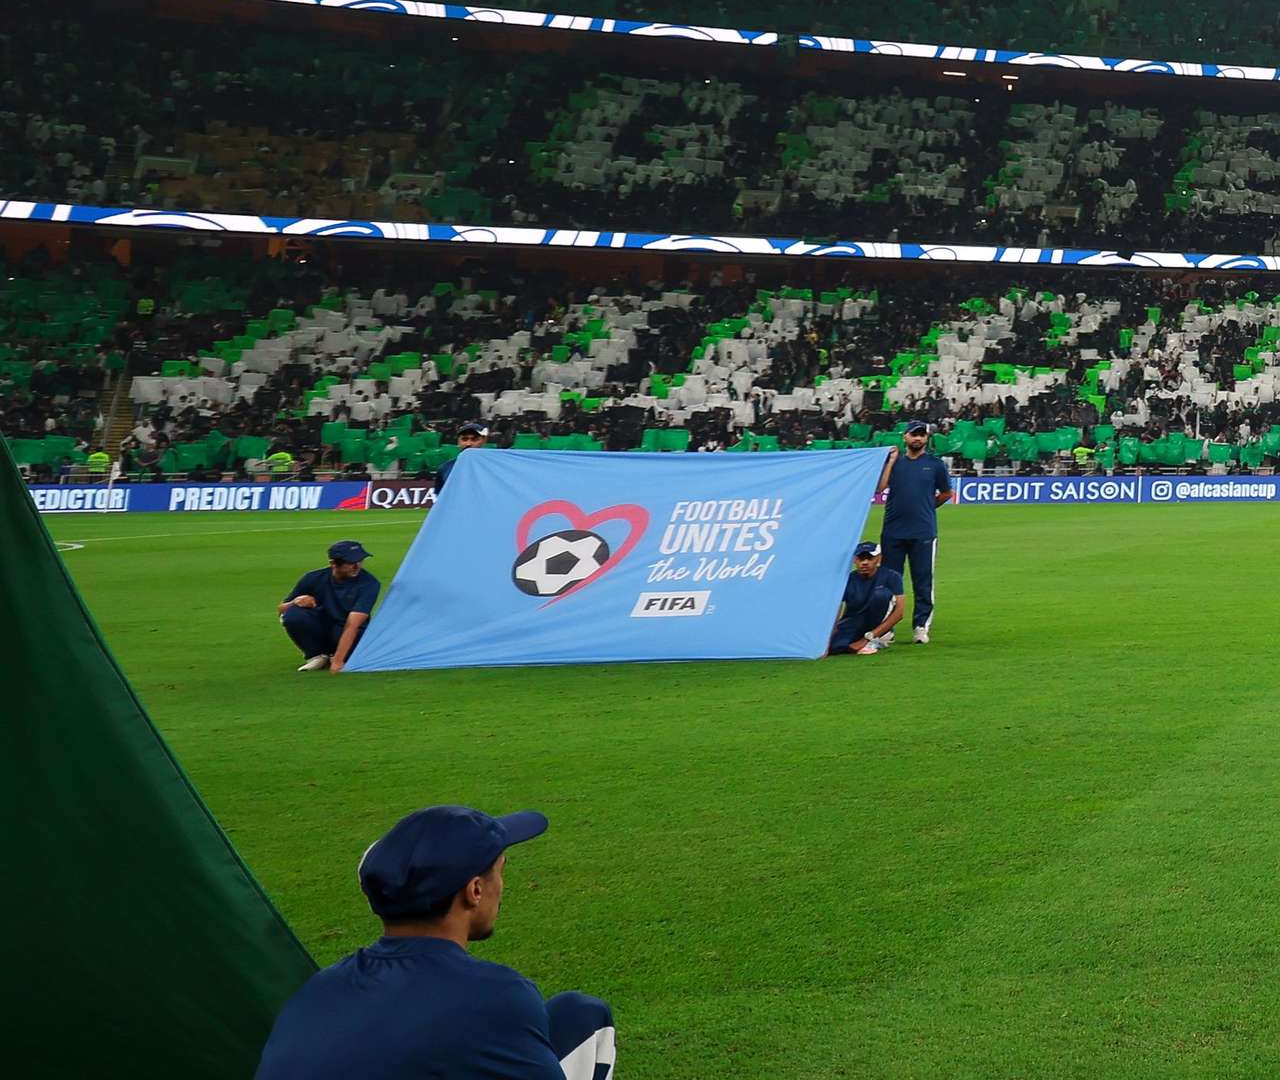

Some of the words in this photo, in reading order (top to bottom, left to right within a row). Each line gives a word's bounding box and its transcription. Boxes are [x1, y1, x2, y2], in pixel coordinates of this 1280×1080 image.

[31, 488, 126, 510] EDICTOR
[169, 487, 265, 511] PREDICT
[269, 486, 323, 510] NOW
[371, 487, 439, 508] QATA
[962, 482, 1045, 501] CREDIT
[1050, 481, 1135, 500] SAISON
[1175, 481, 1276, 499] @afcasiancup
[670, 499, 783, 522] FOOTBALL
[659, 520, 779, 555] UNITES
[647, 557, 690, 584] the
[693, 553, 775, 581] World
[643, 597, 696, 611] FIFA
